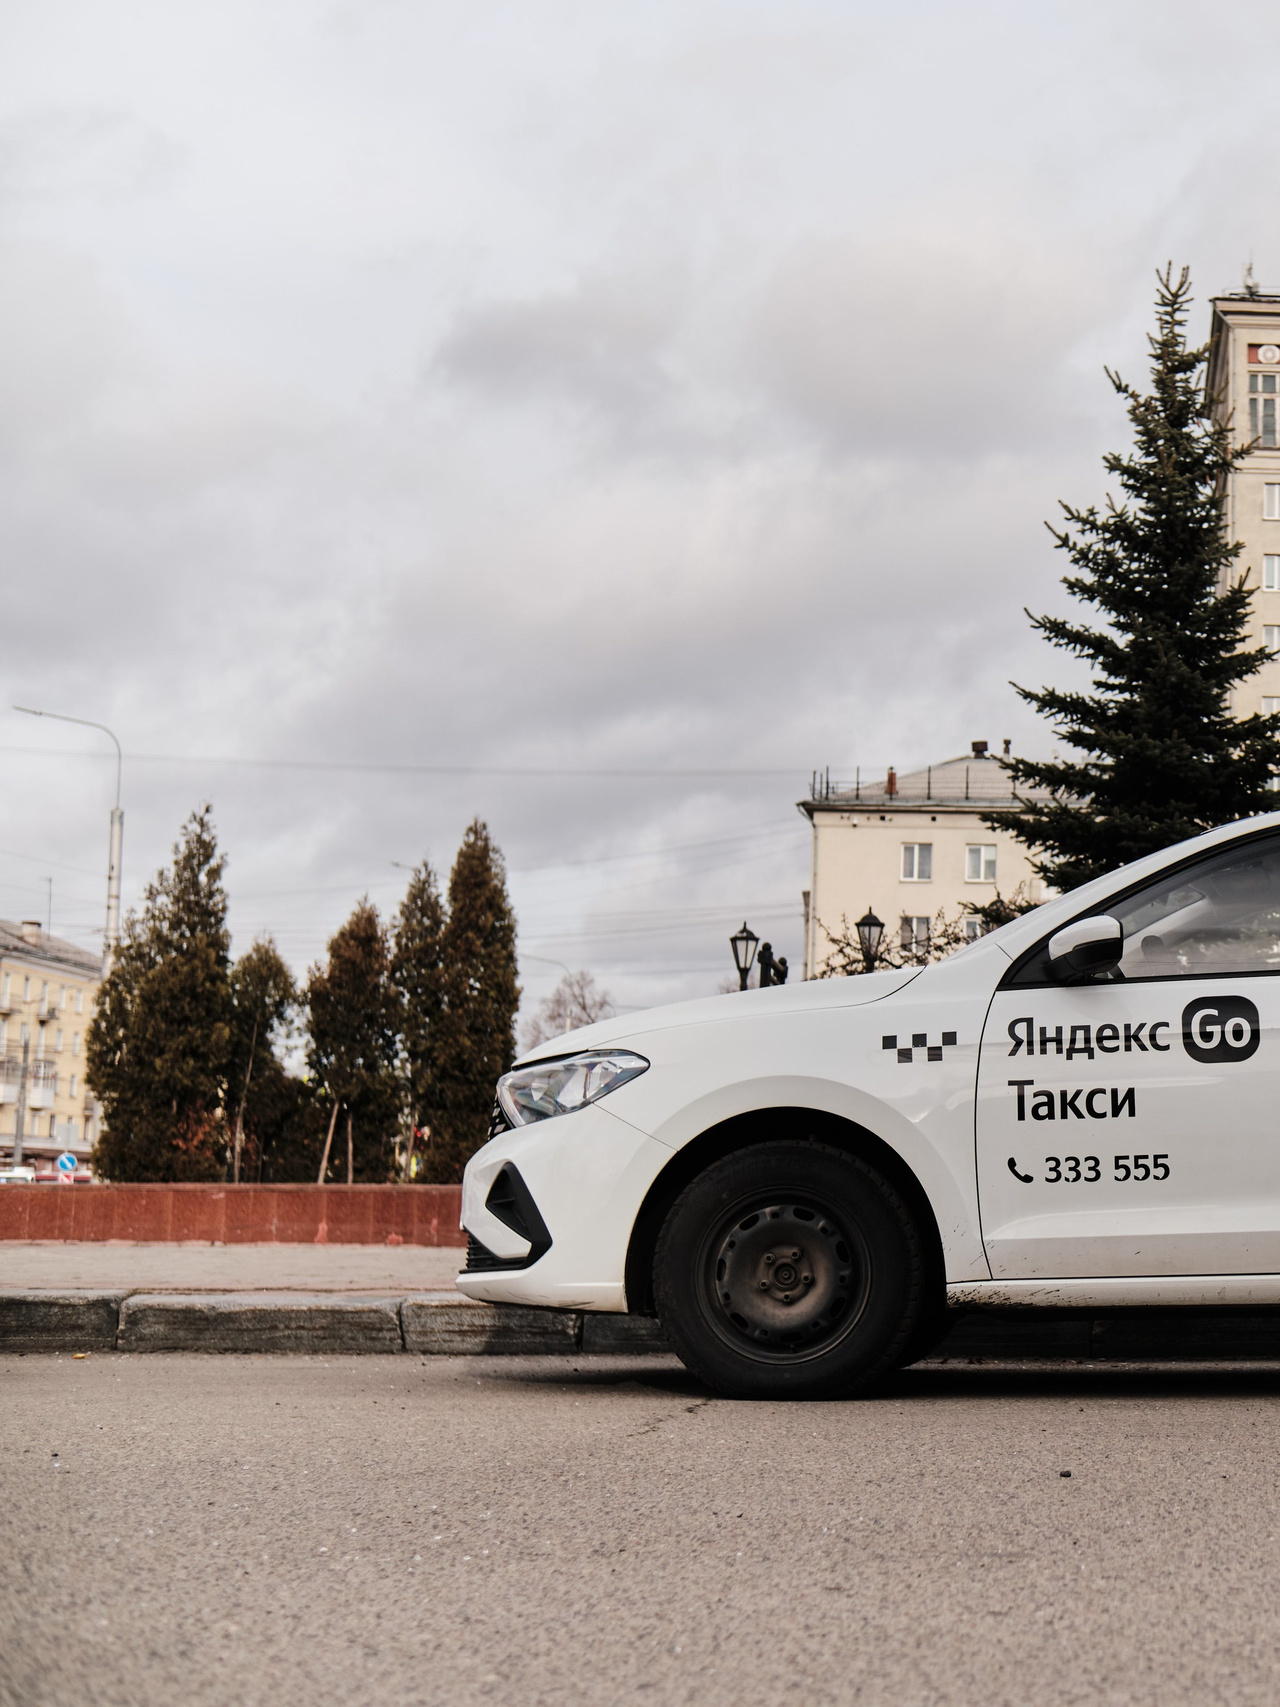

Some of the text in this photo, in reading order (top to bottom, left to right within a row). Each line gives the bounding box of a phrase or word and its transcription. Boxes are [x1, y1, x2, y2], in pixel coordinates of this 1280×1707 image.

[1007, 1008, 1252, 1061] Яндекс Go
[1007, 1079, 1137, 1122] Такси
[1044, 1153, 1171, 1184] 333 555
